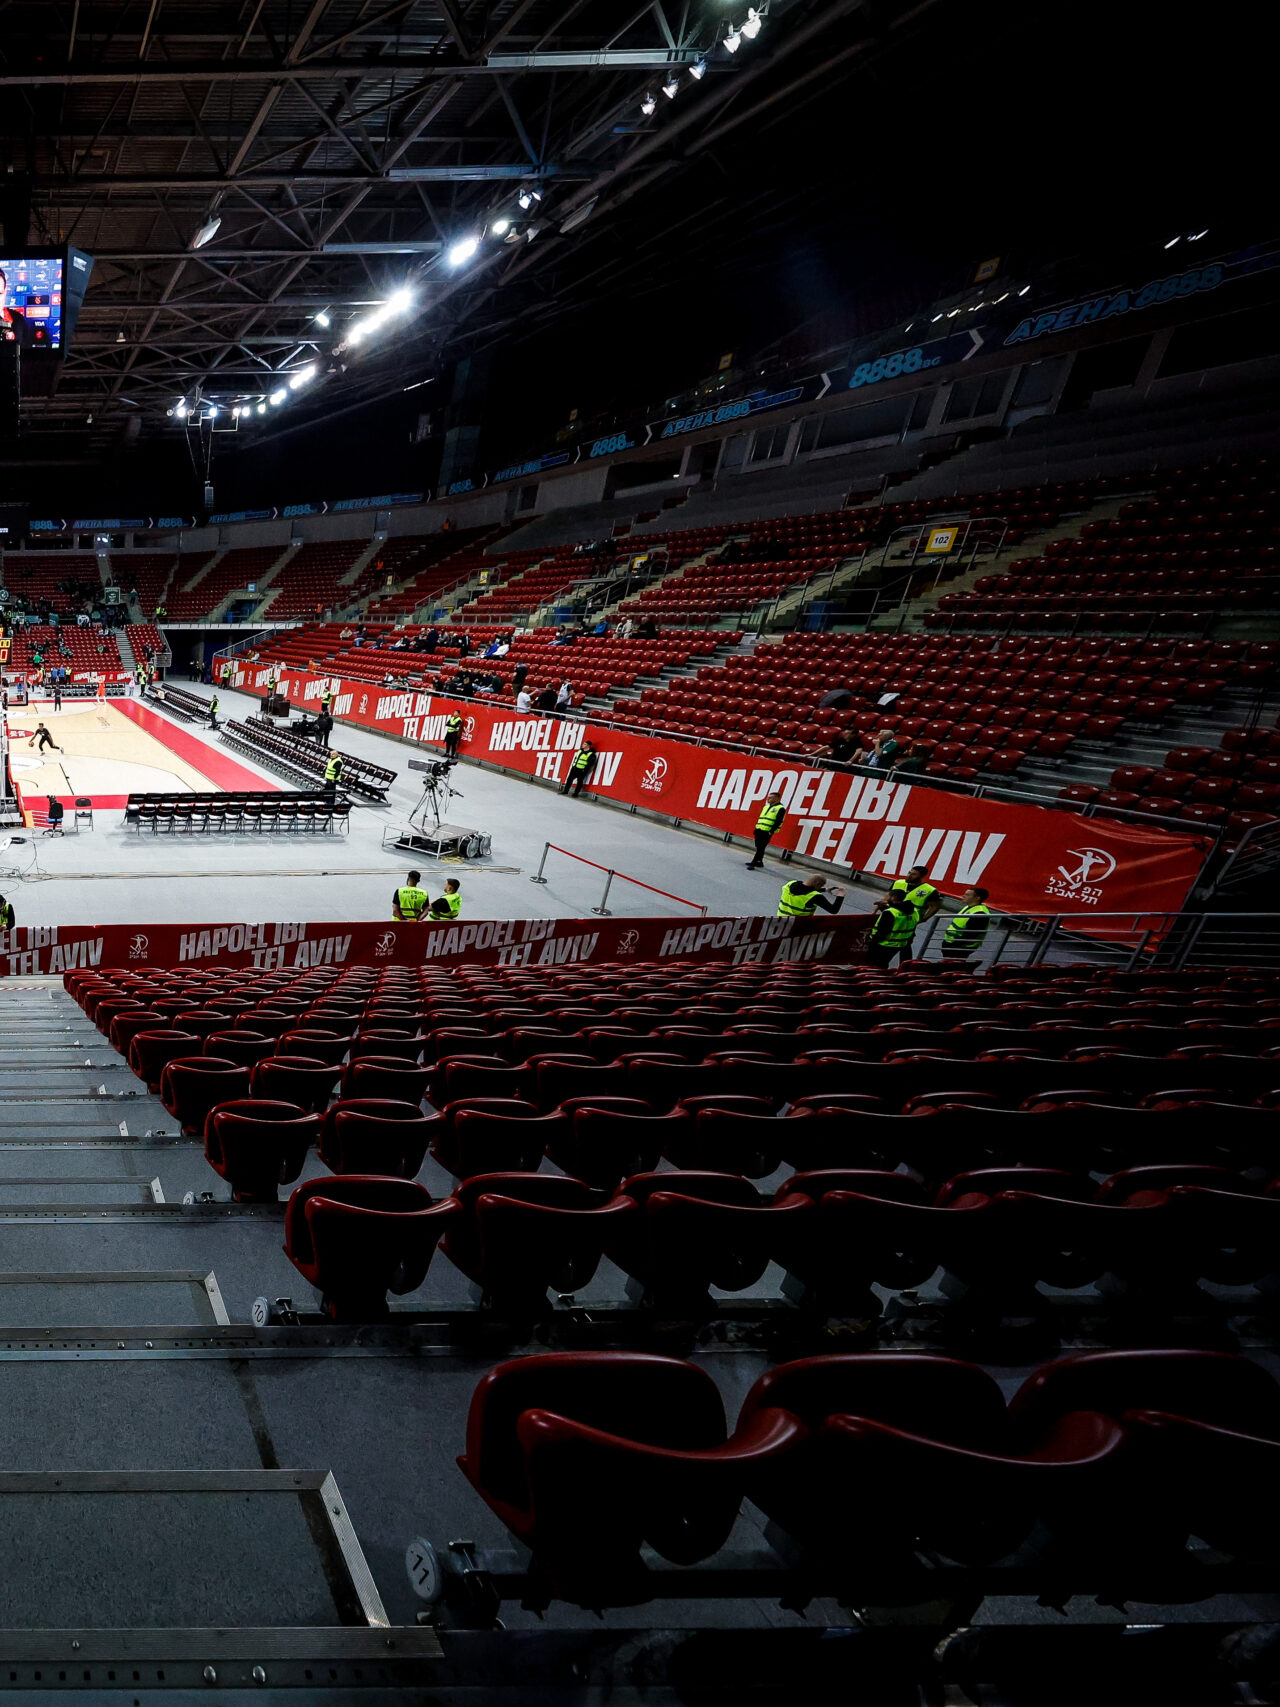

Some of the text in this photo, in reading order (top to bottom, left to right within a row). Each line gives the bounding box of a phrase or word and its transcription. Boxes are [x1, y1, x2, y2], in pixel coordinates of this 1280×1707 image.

[1011, 264, 1223, 338] АРЕНА 8888
[663, 412, 714, 436] АРЕНА
[714, 400, 751, 422] 8888
[933, 535, 949, 545] 102
[333, 693, 353, 716] AVIV
[375, 693, 432, 720] HAPOEL IBI
[402, 718, 420, 741] TEL
[419, 714, 453, 742] AVIV
[488, 718, 586, 751] HAPOEL IBI
[535, 751, 624, 787] TEL IV
[696, 767, 912, 823] HAPOEL IBI
[795, 818, 1007, 886] TEL AVIV
[1044, 885, 1098, 905] תל-אביב
[20, 925, 59, 947] IBI
[178, 921, 308, 962] HAPOEL IBI
[293, 934, 352, 968] AVIV
[425, 918, 558, 960] HAPOEL IBI
[539, 931, 600, 963] AVIV
[658, 916, 795, 958] HAPOEL IBI
[773, 930, 837, 963] AVIV
[6, 937, 104, 976] TEL AVIV
[254, 1304, 264, 1323] 10
